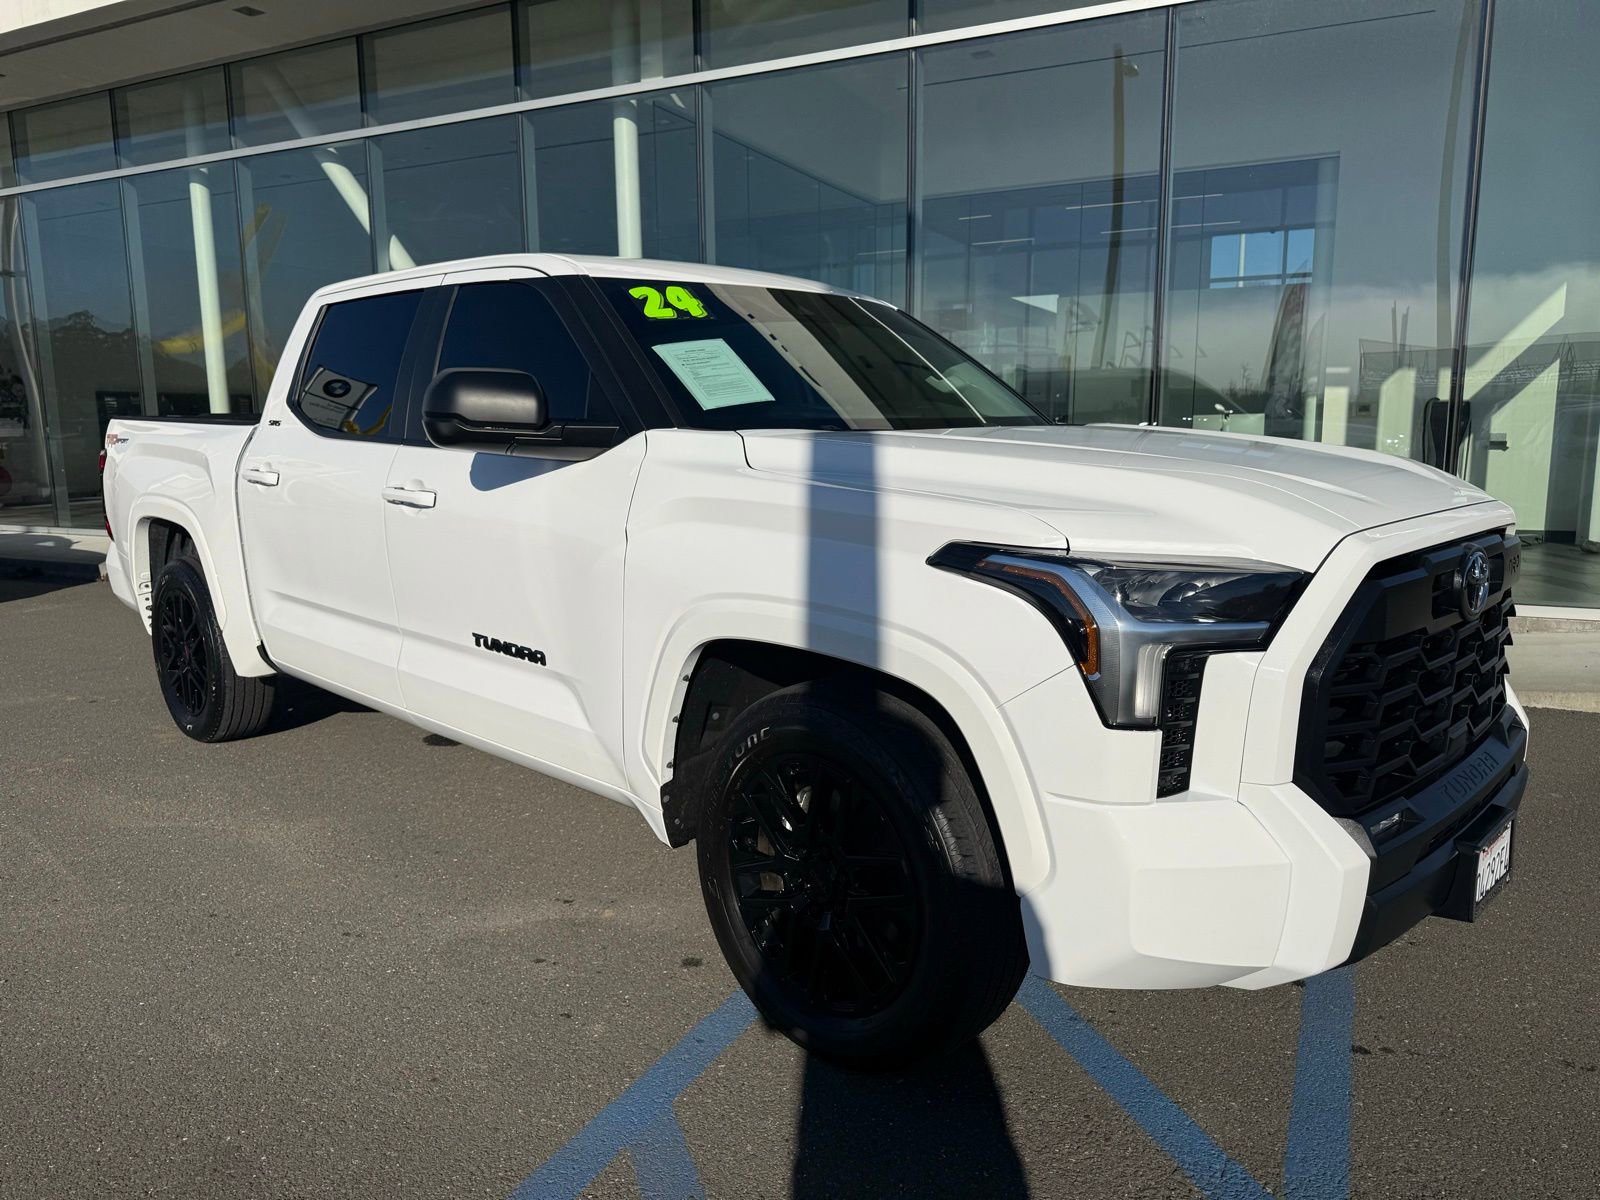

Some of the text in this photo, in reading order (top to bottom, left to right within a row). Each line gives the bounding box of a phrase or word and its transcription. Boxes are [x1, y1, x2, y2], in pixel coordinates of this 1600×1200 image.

[628, 286, 708, 318] 24
[471, 632, 547, 667] TUNDRA
[1441, 751, 1500, 803] TUNDRA
